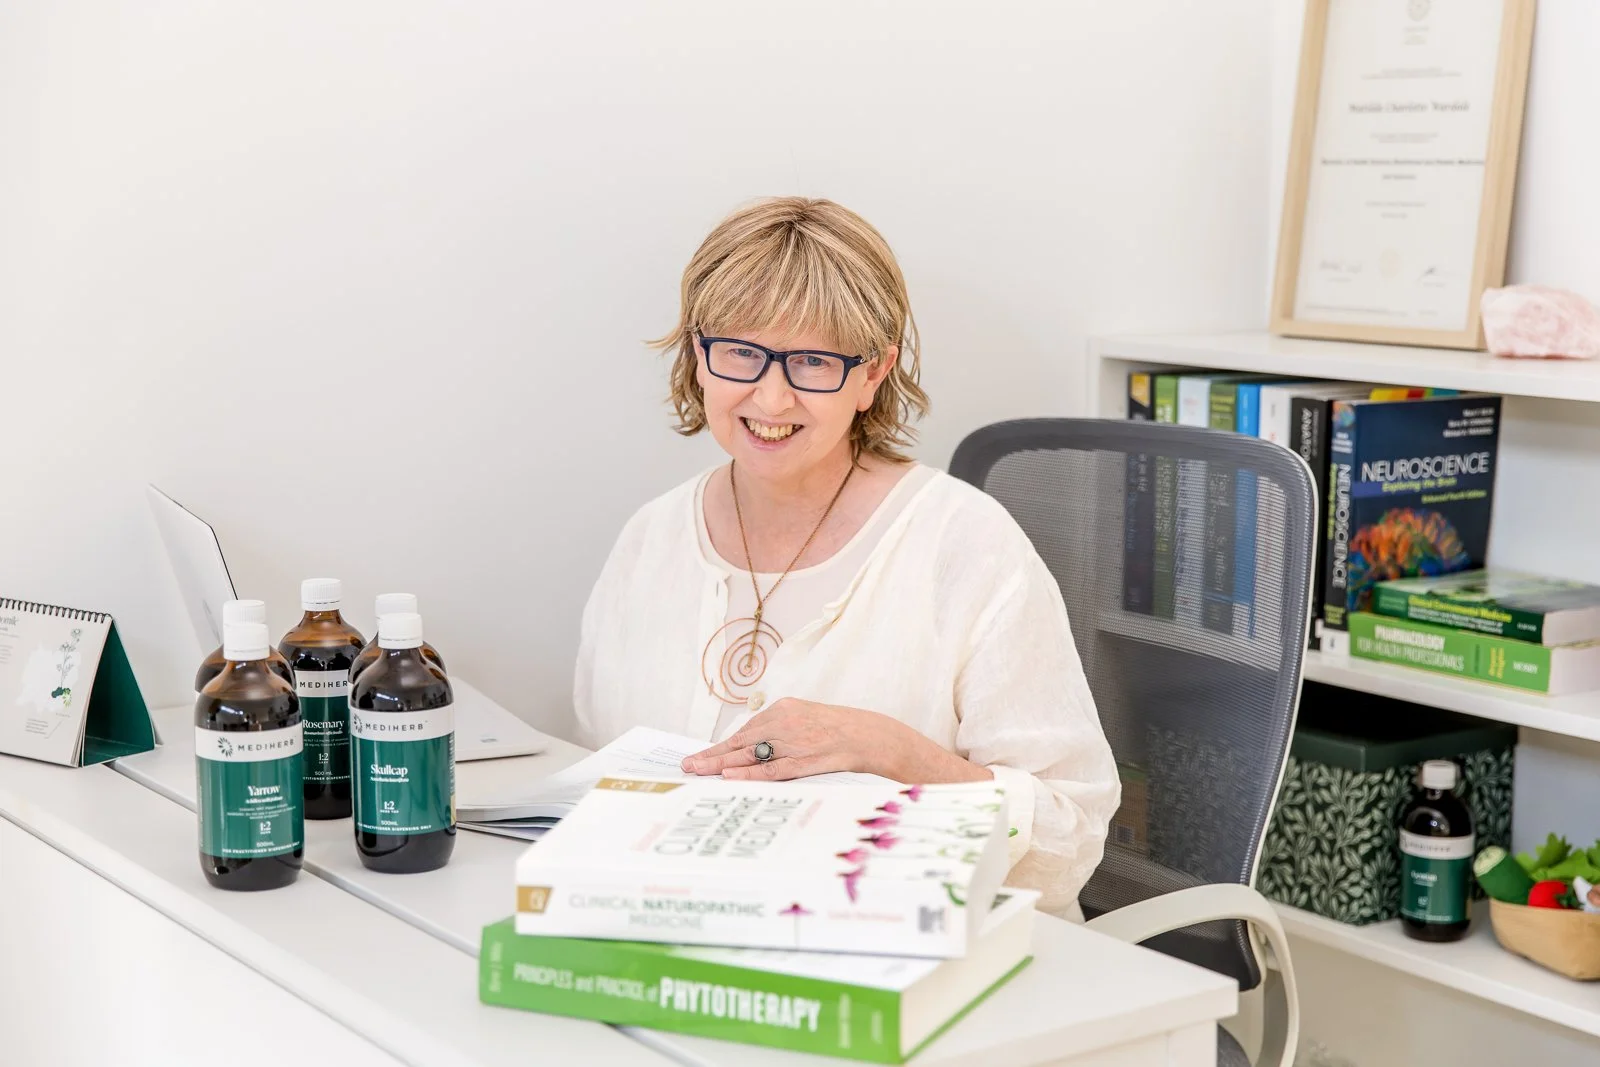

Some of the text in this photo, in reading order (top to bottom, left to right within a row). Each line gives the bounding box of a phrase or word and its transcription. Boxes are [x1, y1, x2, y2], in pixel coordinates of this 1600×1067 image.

[1362, 451, 1490, 482] NEUROSCIENCE
[1332, 464, 1351, 589] NEUROSCIENCE
[1402, 644, 1465, 672] PROFESSIONALS
[299, 680, 348, 689] MEDIHER
[302, 719, 344, 730] Rosemary
[365, 723, 424, 732] MEDIHERB
[238, 739, 295, 752] MEDIHERB
[318, 753, 329, 761] 1:2
[370, 764, 408, 777] Skullcap
[248, 785, 281, 797] Yarrow
[384, 800, 396, 810] 1:2
[260, 821, 272, 831] 1:2
[568, 893, 638, 911] CLINICAL
[641, 898, 766, 918] NATUROPATHIC
[628, 913, 703, 930] MEDICINE
[513, 960, 574, 990] PRINCIPLES
[575, 975, 595, 993] and
[595, 974, 645, 1001] PRACTICE
[659, 975, 822, 1034] PHYTOTHERAPY
